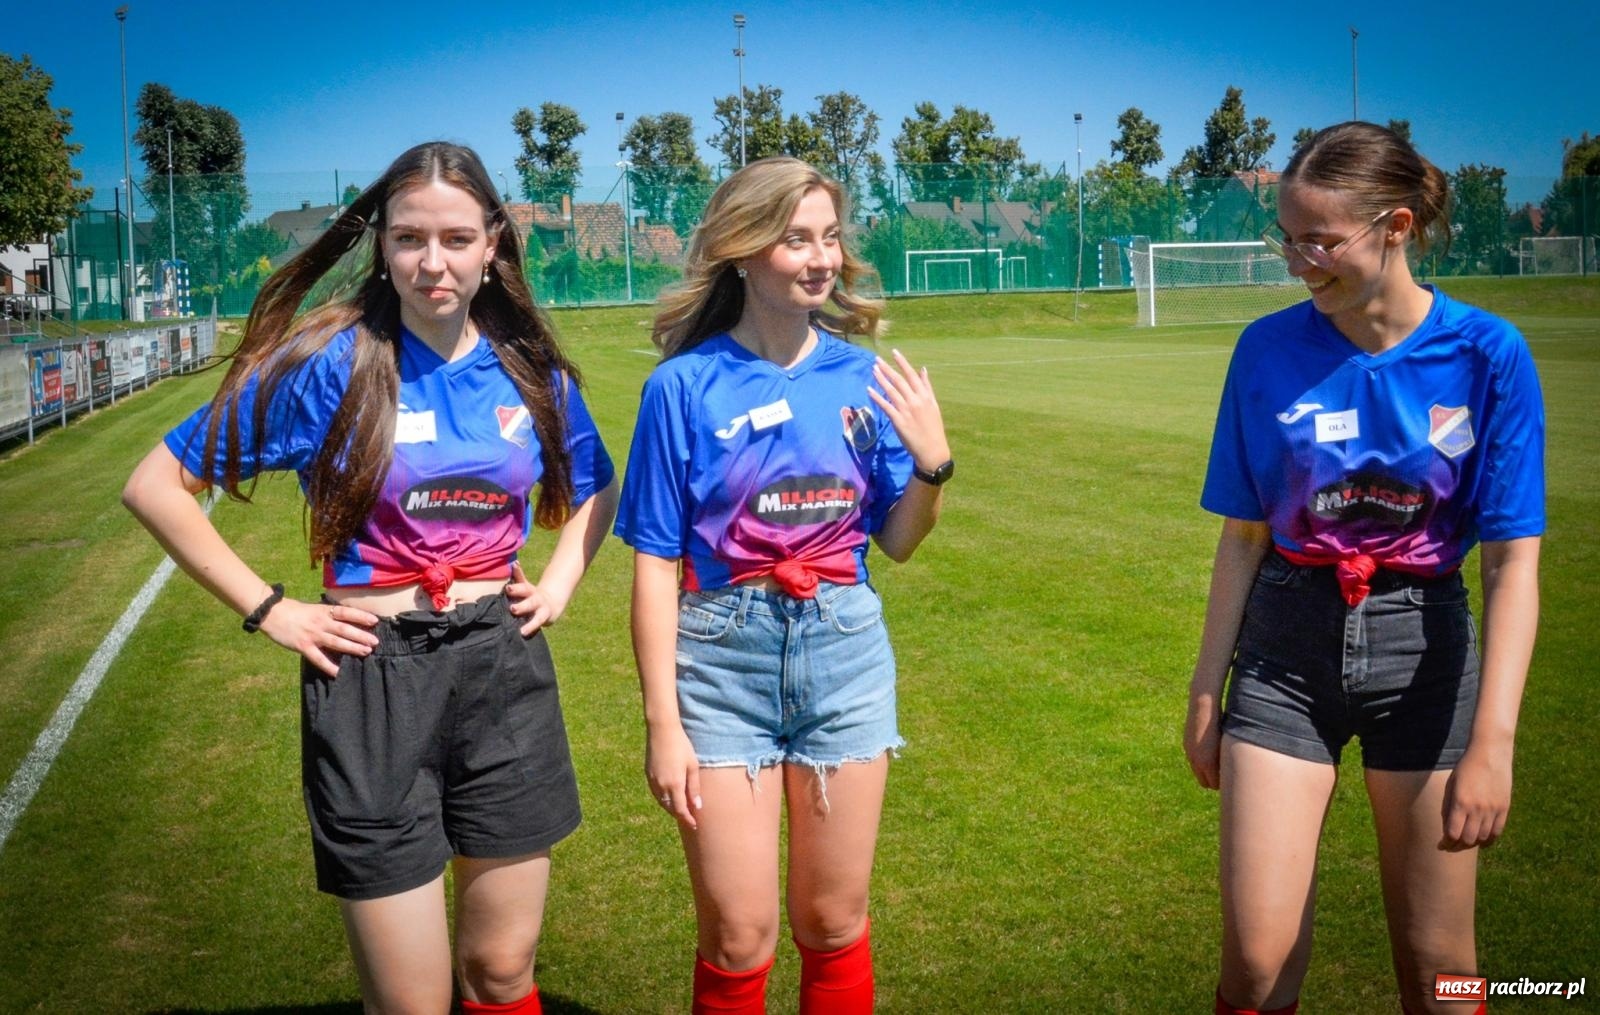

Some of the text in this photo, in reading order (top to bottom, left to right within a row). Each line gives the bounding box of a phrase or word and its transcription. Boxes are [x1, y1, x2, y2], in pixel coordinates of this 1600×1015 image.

[1328, 422, 1347, 432] OLA
[406, 489, 509, 511] MILION
[445, 500, 505, 510] MARKET
[757, 488, 855, 513] MILION
[800, 500, 854, 510] MARKET
[1363, 495, 1424, 513] MARKET
